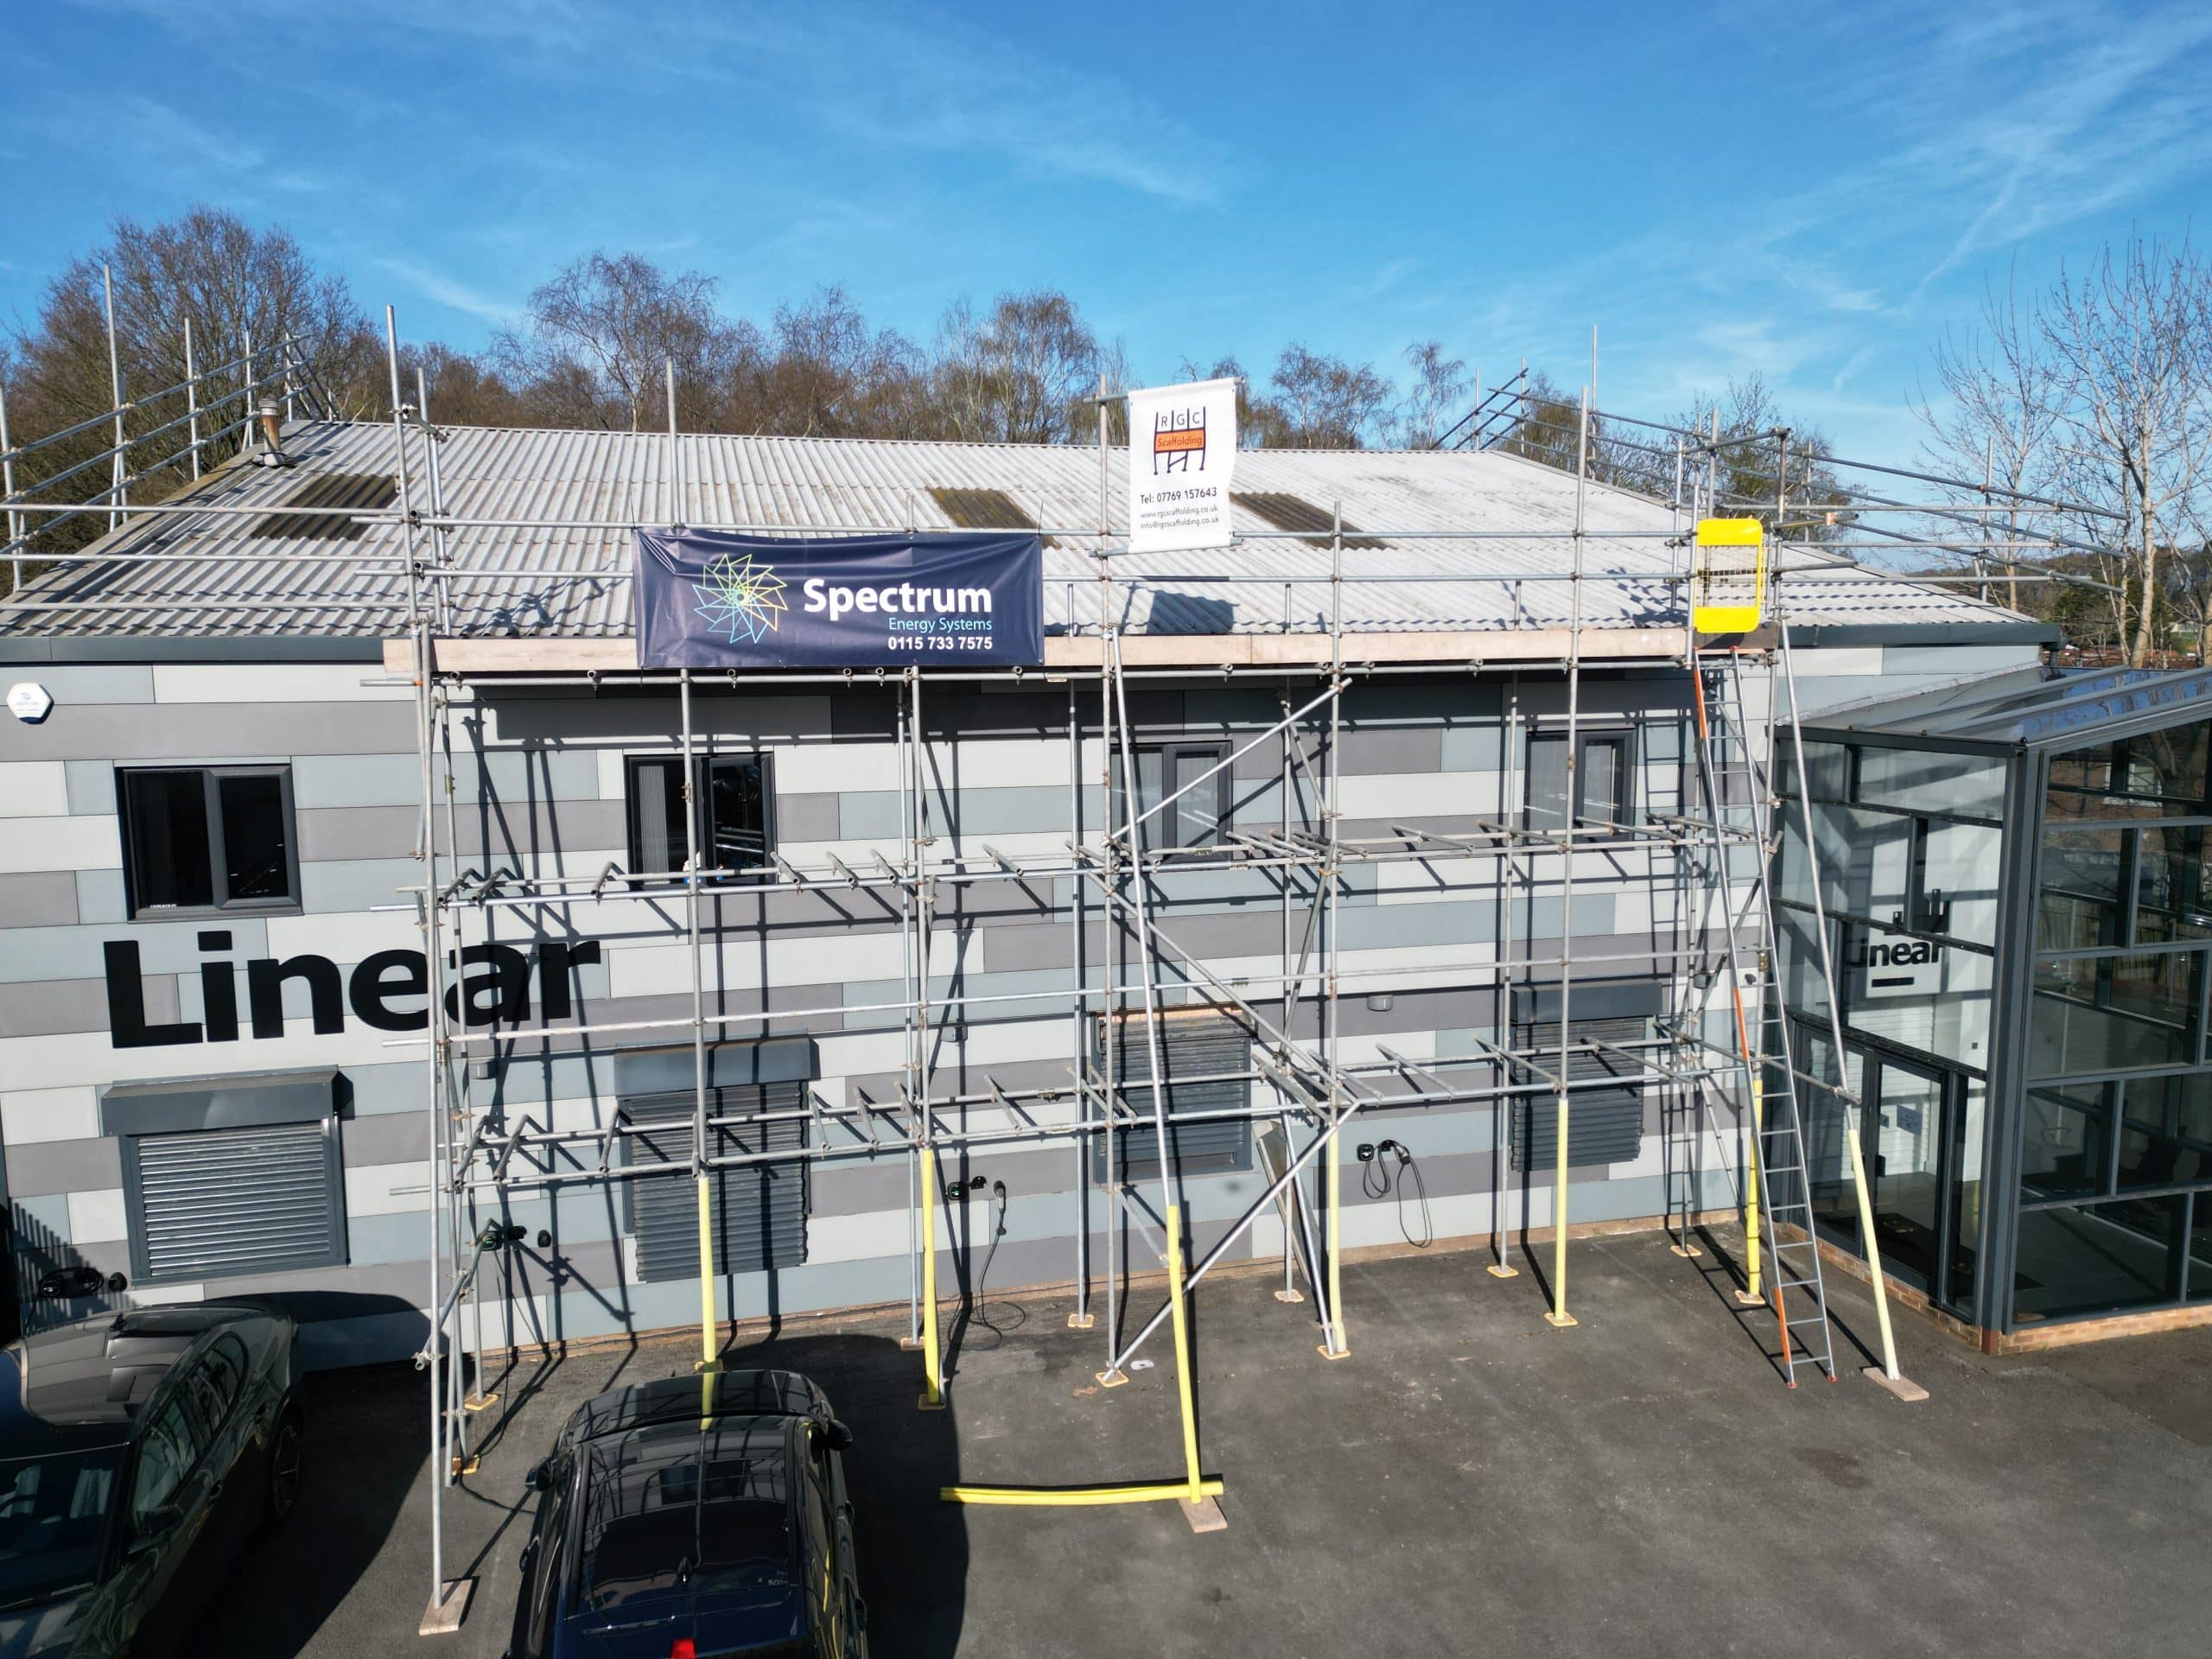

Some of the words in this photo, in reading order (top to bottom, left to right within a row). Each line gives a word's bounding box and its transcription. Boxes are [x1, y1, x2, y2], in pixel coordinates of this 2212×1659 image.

[1157, 435, 1203, 448] Scaffolding
[1141, 493, 1154, 504] Tel:
[1157, 490, 1181, 503] 07769
[1185, 486, 1217, 499] 157643
[803, 578, 992, 620] Spectrum
[889, 618, 936, 632] Energy
[939, 618, 992, 632] Systems
[888, 637, 924, 650] 0115
[927, 637, 954, 650] 733
[957, 636, 993, 650] 7575
[104, 930, 601, 1049] Linear
